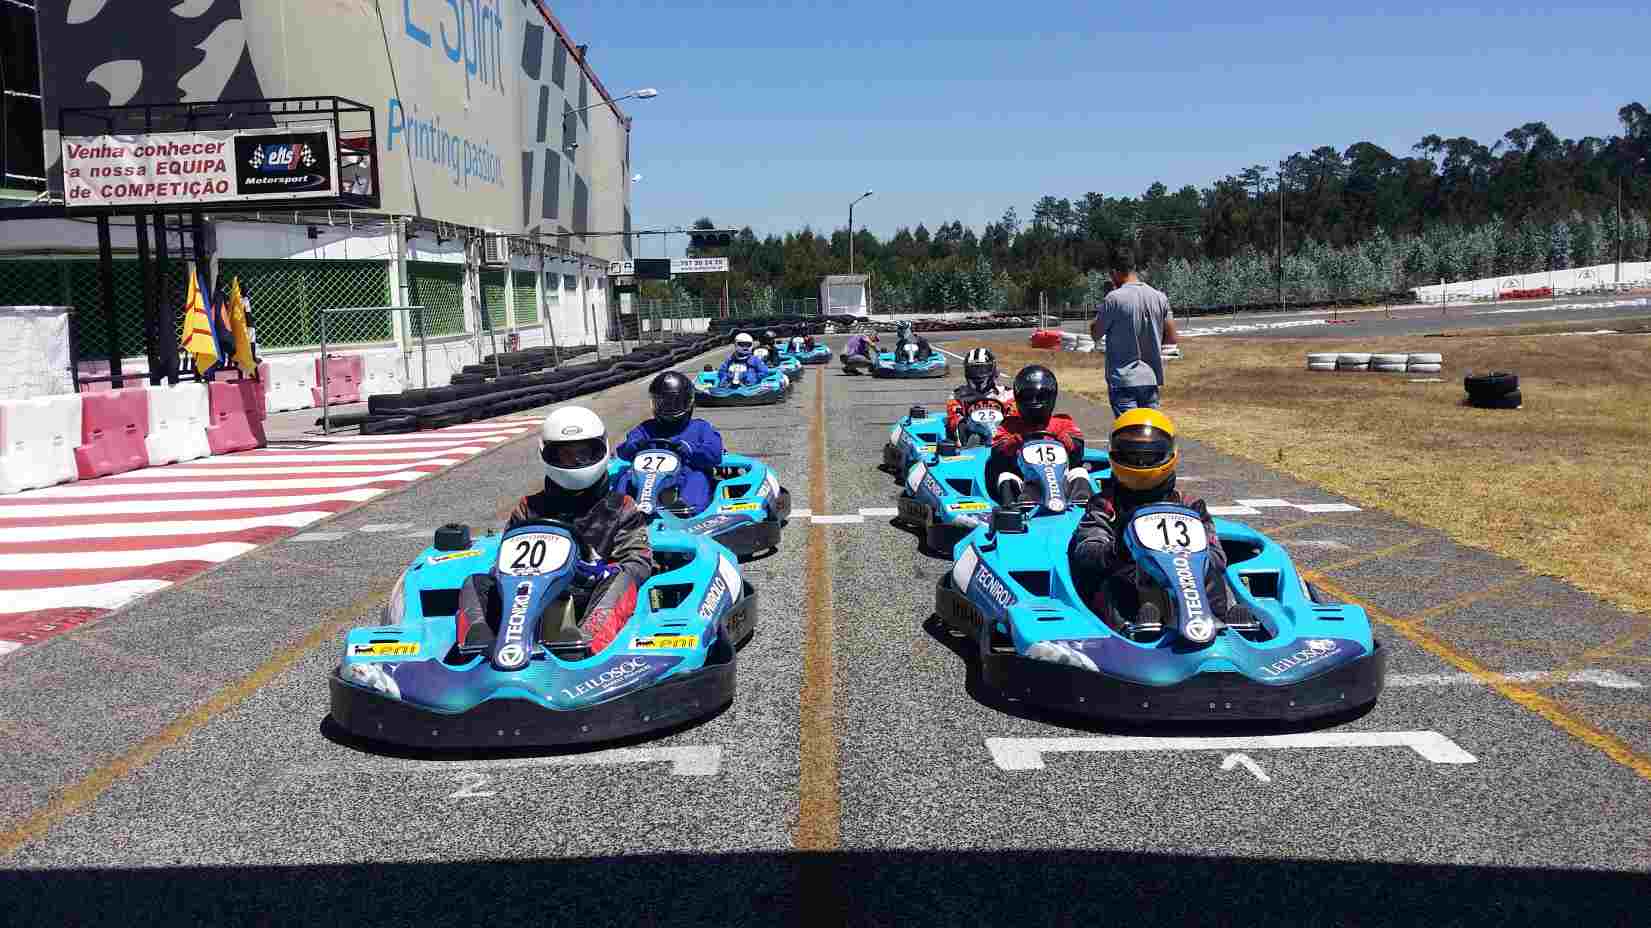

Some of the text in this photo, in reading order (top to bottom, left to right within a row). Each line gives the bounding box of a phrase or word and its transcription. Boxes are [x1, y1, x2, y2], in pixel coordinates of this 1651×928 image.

[67, 141, 225, 159] Venha conhecer
[387, 97, 461, 185] Printing
[68, 160, 227, 178] a nossa EQUIPA
[245, 175, 308, 185] Motorsport
[69, 180, 229, 199] de COMPETIÇÃO
[978, 411, 997, 421] 25
[642, 456, 666, 470] 27
[1035, 447, 1056, 462] 15
[1157, 518, 1191, 547] 13
[510, 539, 547, 569] 20
[1173, 555, 1203, 619] TECNIROLO
[560, 655, 648, 699] LEILOSOC
